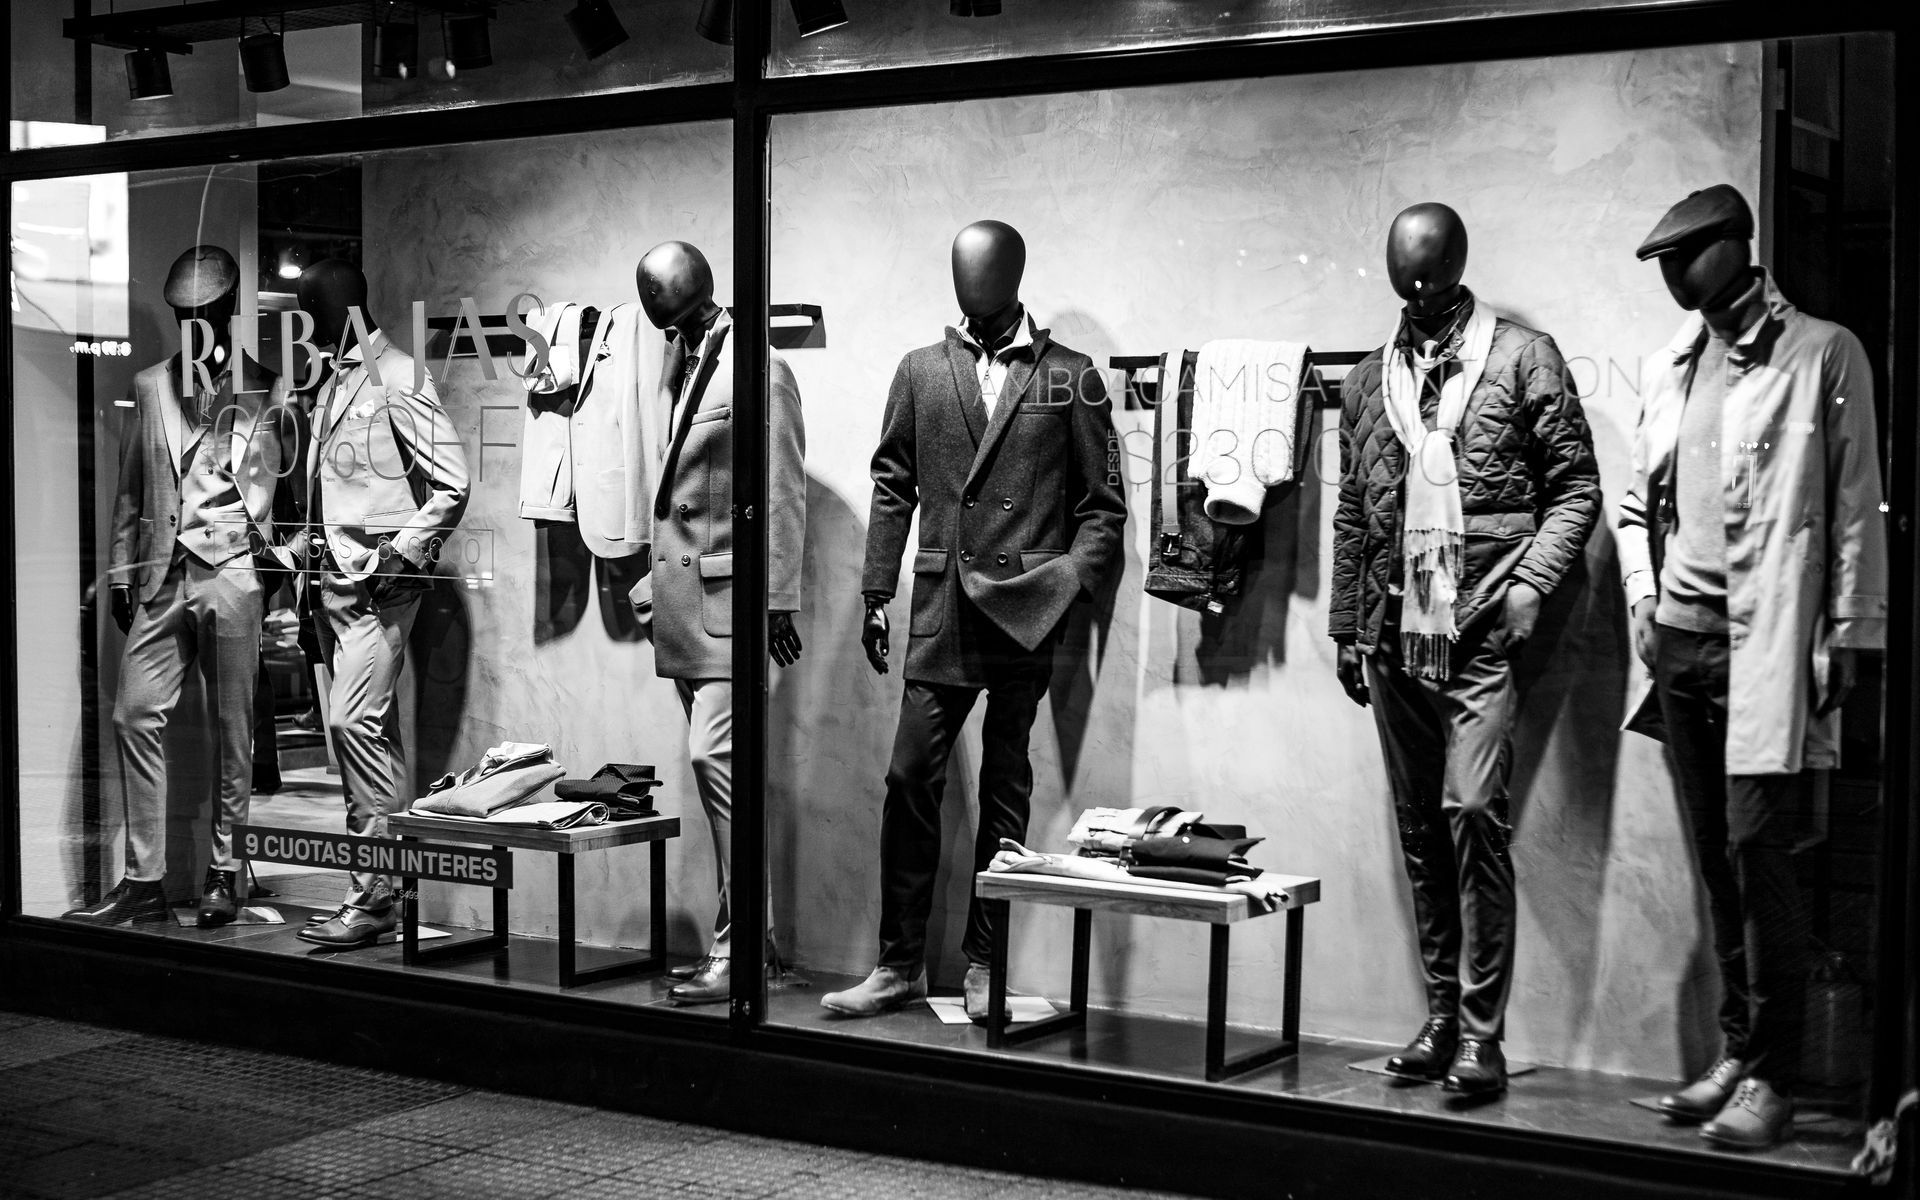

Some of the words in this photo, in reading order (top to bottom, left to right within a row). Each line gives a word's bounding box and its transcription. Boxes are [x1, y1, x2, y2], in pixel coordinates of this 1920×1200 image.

[180, 293, 550, 398] REBAJAS
[1107, 428, 1120, 487] DESDE
[245, 833, 259, 856] 9
[263, 835, 351, 865] CUOTAS
[357, 844, 394, 870] SIN
[400, 850, 498, 881] INTERES
